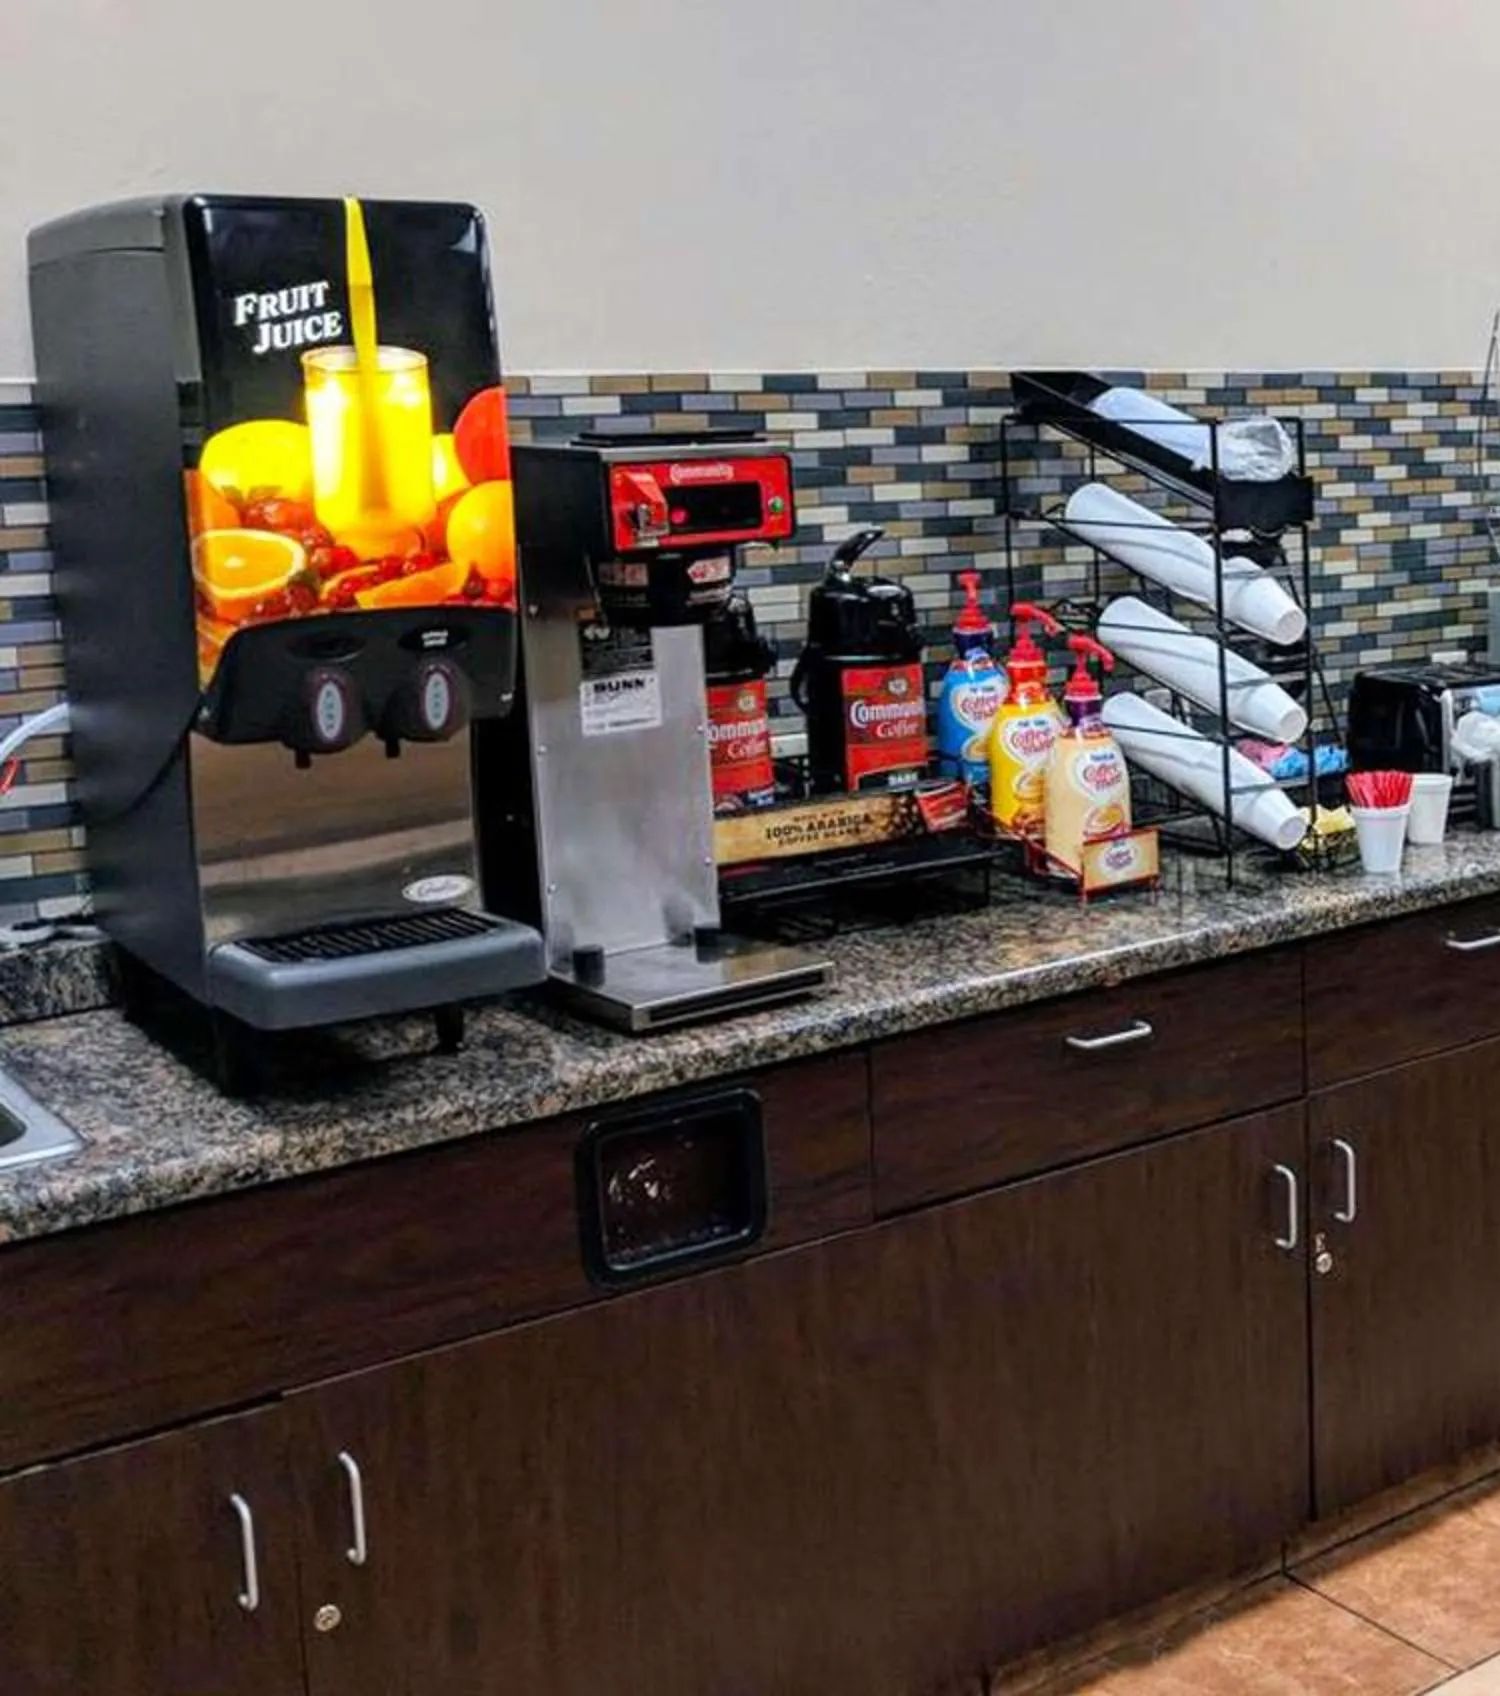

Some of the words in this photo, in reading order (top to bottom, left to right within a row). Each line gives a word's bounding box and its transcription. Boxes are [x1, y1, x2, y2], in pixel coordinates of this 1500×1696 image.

[234, 280, 329, 326] FRUIT
[252, 311, 342, 354] JUICE
[594, 678, 645, 693] BUNN
[806, 812, 874, 832] ARABICA
